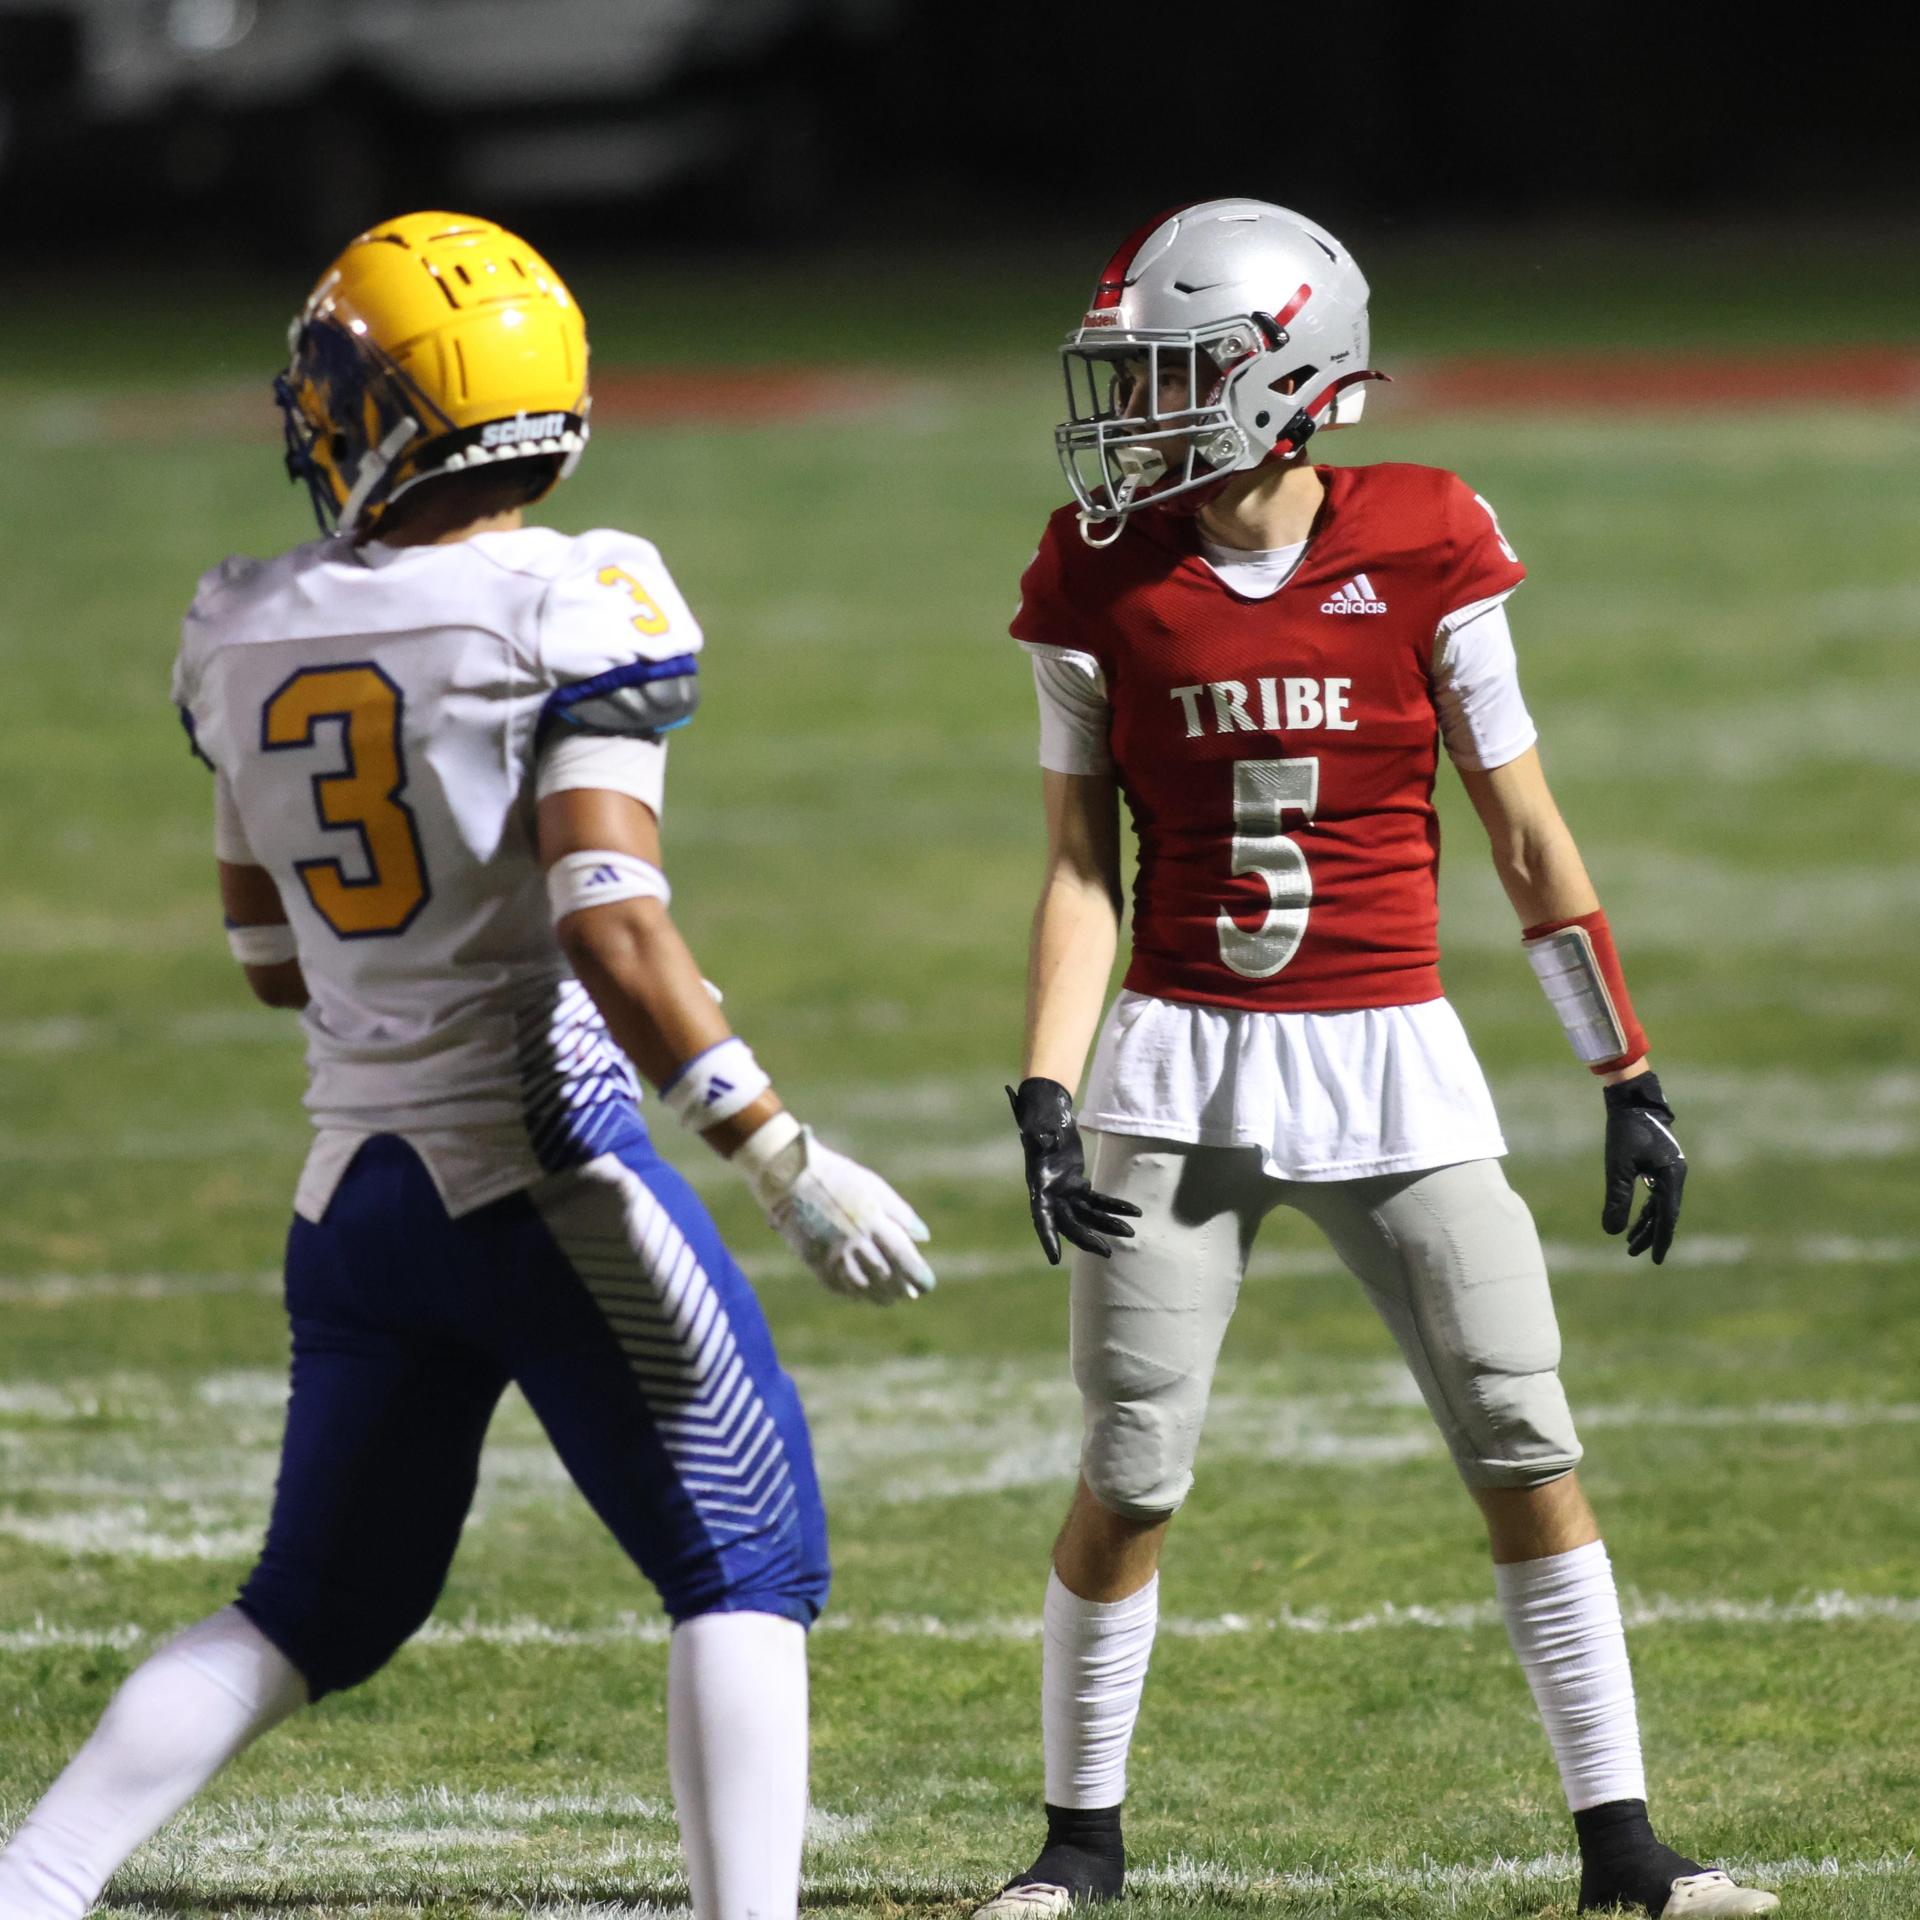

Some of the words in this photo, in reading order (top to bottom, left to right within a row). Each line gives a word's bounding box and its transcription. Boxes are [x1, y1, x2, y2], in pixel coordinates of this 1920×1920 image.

[481, 409, 567, 447] schutt
[596, 564, 670, 637] 3
[1320, 599, 1388, 614] adidas
[1169, 677, 1359, 738] TRIBE
[261, 661, 432, 941] 3
[1216, 757, 1319, 978] 5
